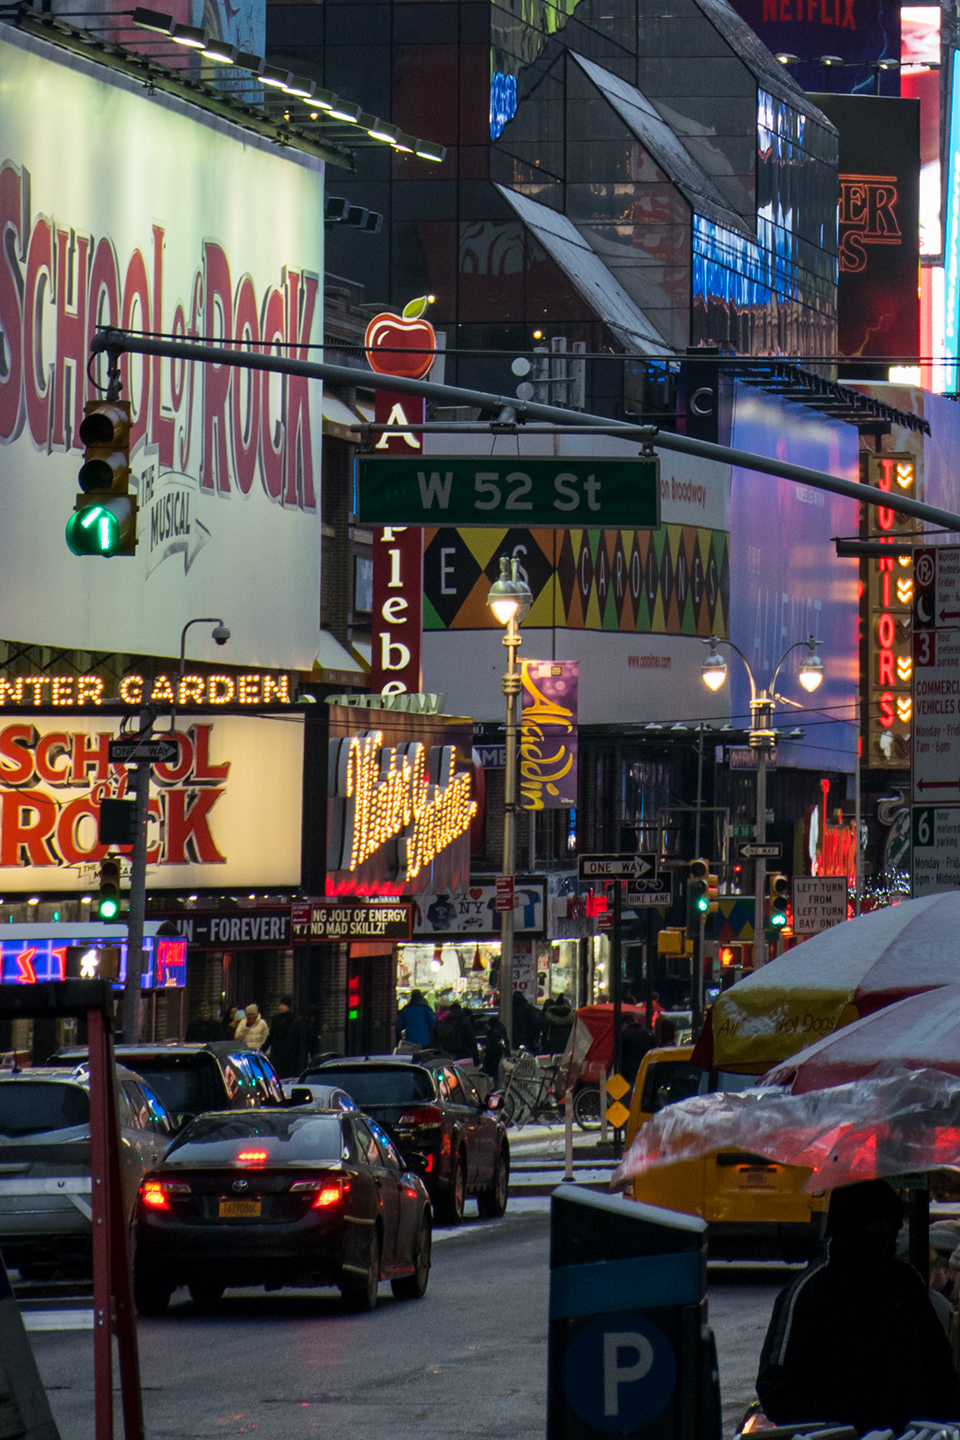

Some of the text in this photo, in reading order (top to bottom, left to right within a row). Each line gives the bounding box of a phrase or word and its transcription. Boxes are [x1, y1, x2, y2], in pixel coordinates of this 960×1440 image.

[199, 236, 321, 515] ROCK
[140, 467, 156, 507] THE
[417, 471, 602, 511] W 52 St
[671, 475, 707, 510] Broadway
[149, 487, 192, 539] MUSICAL
[581, 545, 717, 607] CAROLINES
[918, 632, 931, 664] 3
[119, 674, 289, 705] GARDEN
[916, 699, 955, 715] VEHICLES
[114, 746, 172, 757] ONE WAY
[918, 811, 928, 843] 6
[589, 861, 644, 873] ONE WAY
[629, 892, 671, 904] BIKE LANE
[797, 882, 844, 893] LEFT TURN
[808, 895, 832, 904] FROM
[328, 909, 352, 922] JOLT
[353, 909, 368, 922] OF
[797, 906, 844, 917] LEFT TURN
[799, 918, 841, 928] BAY ONLY
[326, 922, 348, 935] MAD
[603, 1330, 655, 1417] P
